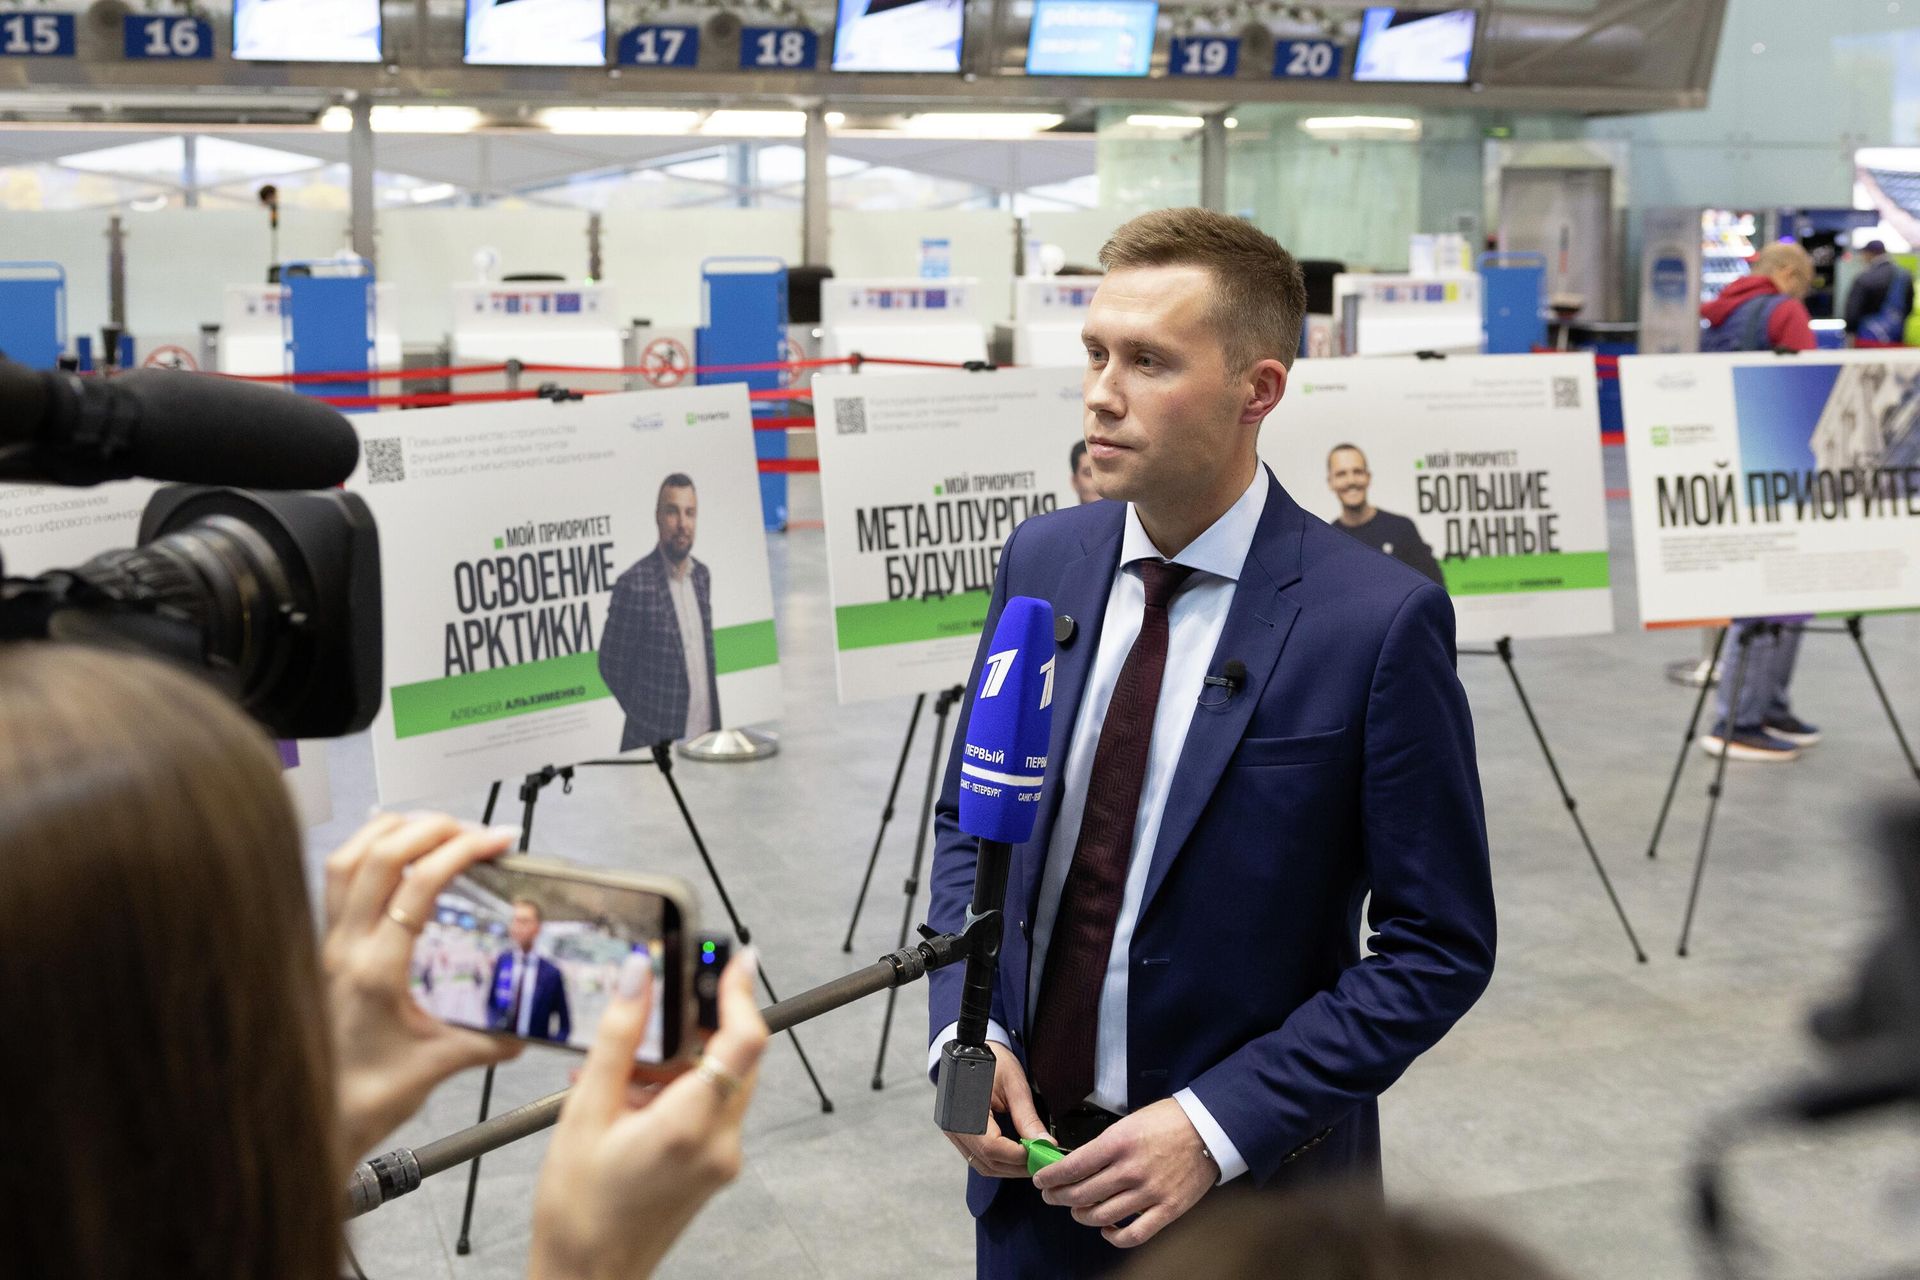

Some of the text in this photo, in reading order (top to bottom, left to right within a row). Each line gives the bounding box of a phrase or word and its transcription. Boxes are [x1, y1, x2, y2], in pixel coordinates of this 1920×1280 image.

[4, 15, 60, 53] 15
[144, 18, 200, 56] 16
[635, 29, 686, 63] 17
[756, 31, 806, 66] 18
[1182, 41, 1229, 74] 19
[1286, 43, 1333, 77] 20
[1425, 449, 1518, 468] МОЙ ПРИОРИТЕТ
[944, 470, 1036, 495] МОЙ ПРИОРИТЕТ
[1416, 470, 1551, 513] БОЛЬШИЕ
[1656, 460, 1737, 528] МОЙ
[505, 515, 612, 548] МОЙ ПРИОРИТЕТ
[1443, 514, 1562, 562] ДАННЫЕ
[454, 542, 615, 614] ОСВОЕНИЕ
[445, 601, 594, 678] АРКТИКИ
[965, 743, 1004, 765] ПЕРВЫЙ
